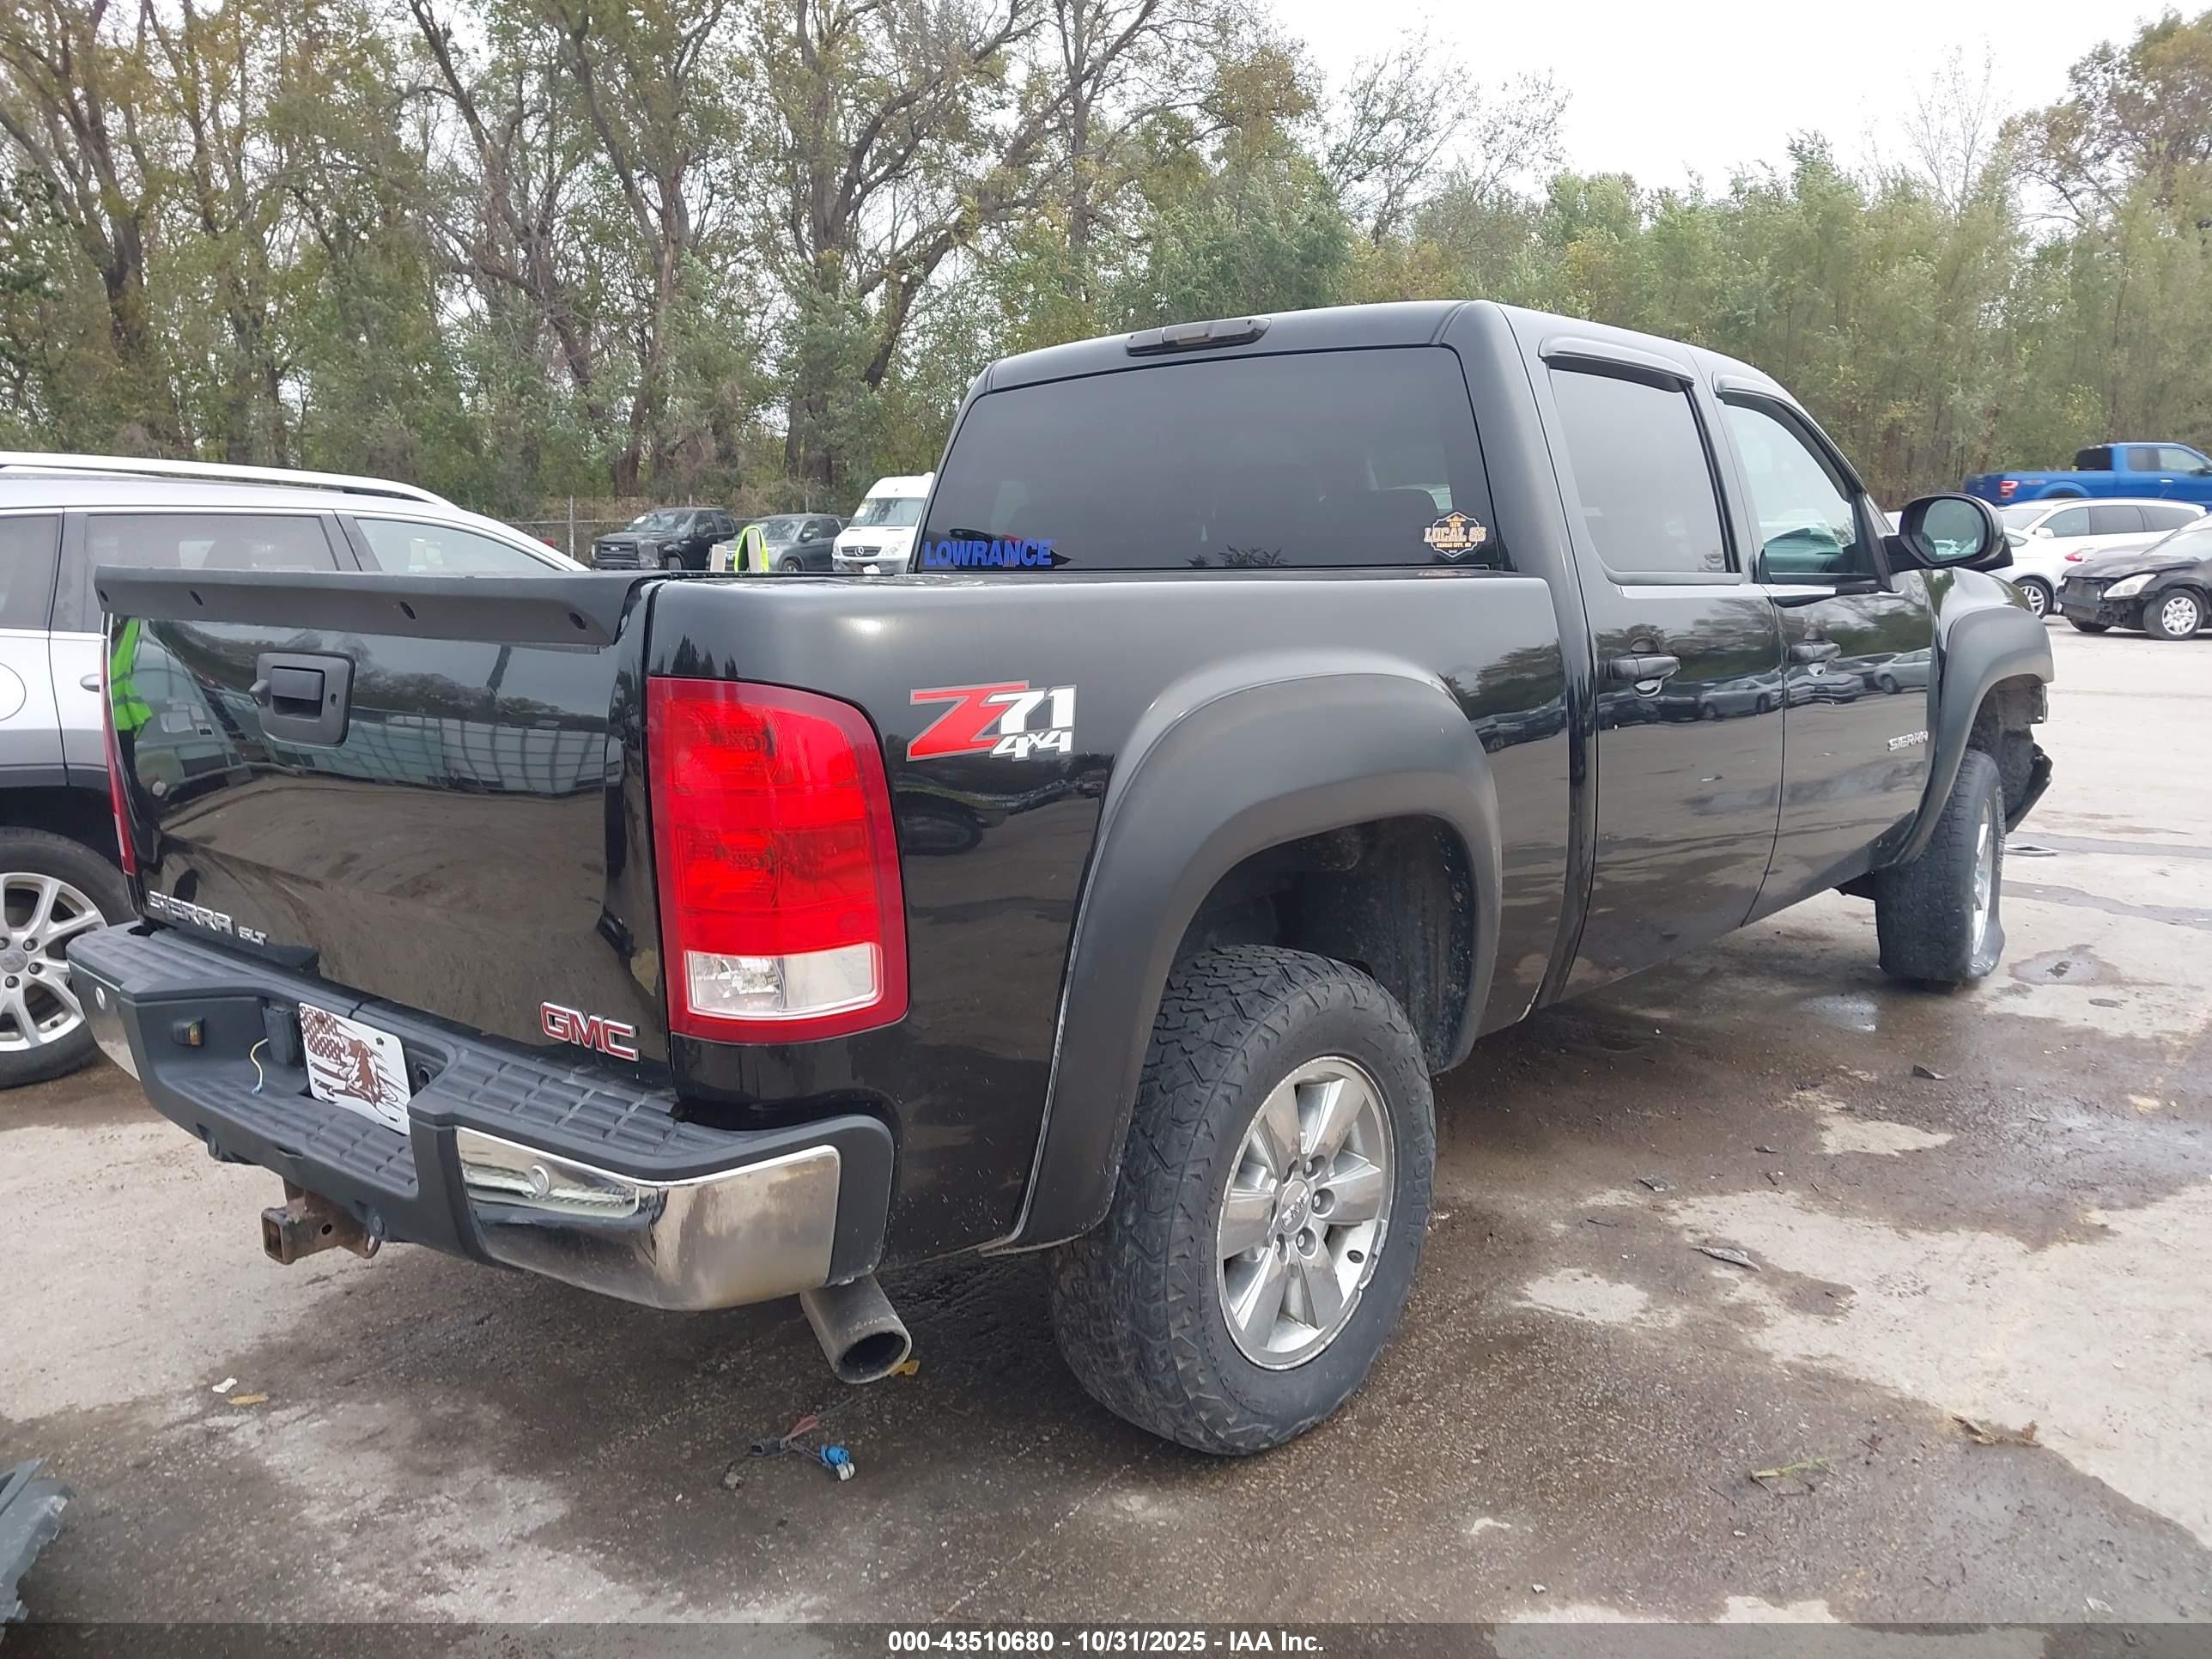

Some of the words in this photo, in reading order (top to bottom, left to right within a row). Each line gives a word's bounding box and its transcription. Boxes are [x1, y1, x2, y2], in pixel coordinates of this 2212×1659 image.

[1424, 526, 1468, 542] LOCAL
[924, 539, 1053, 567] LOWRANCE
[907, 680, 1076, 762] Z71
[1888, 730, 1929, 751] SIERRA
[149, 890, 234, 936] SIERRA
[238, 925, 269, 946] SLT
[540, 1001, 640, 1062] GMC
